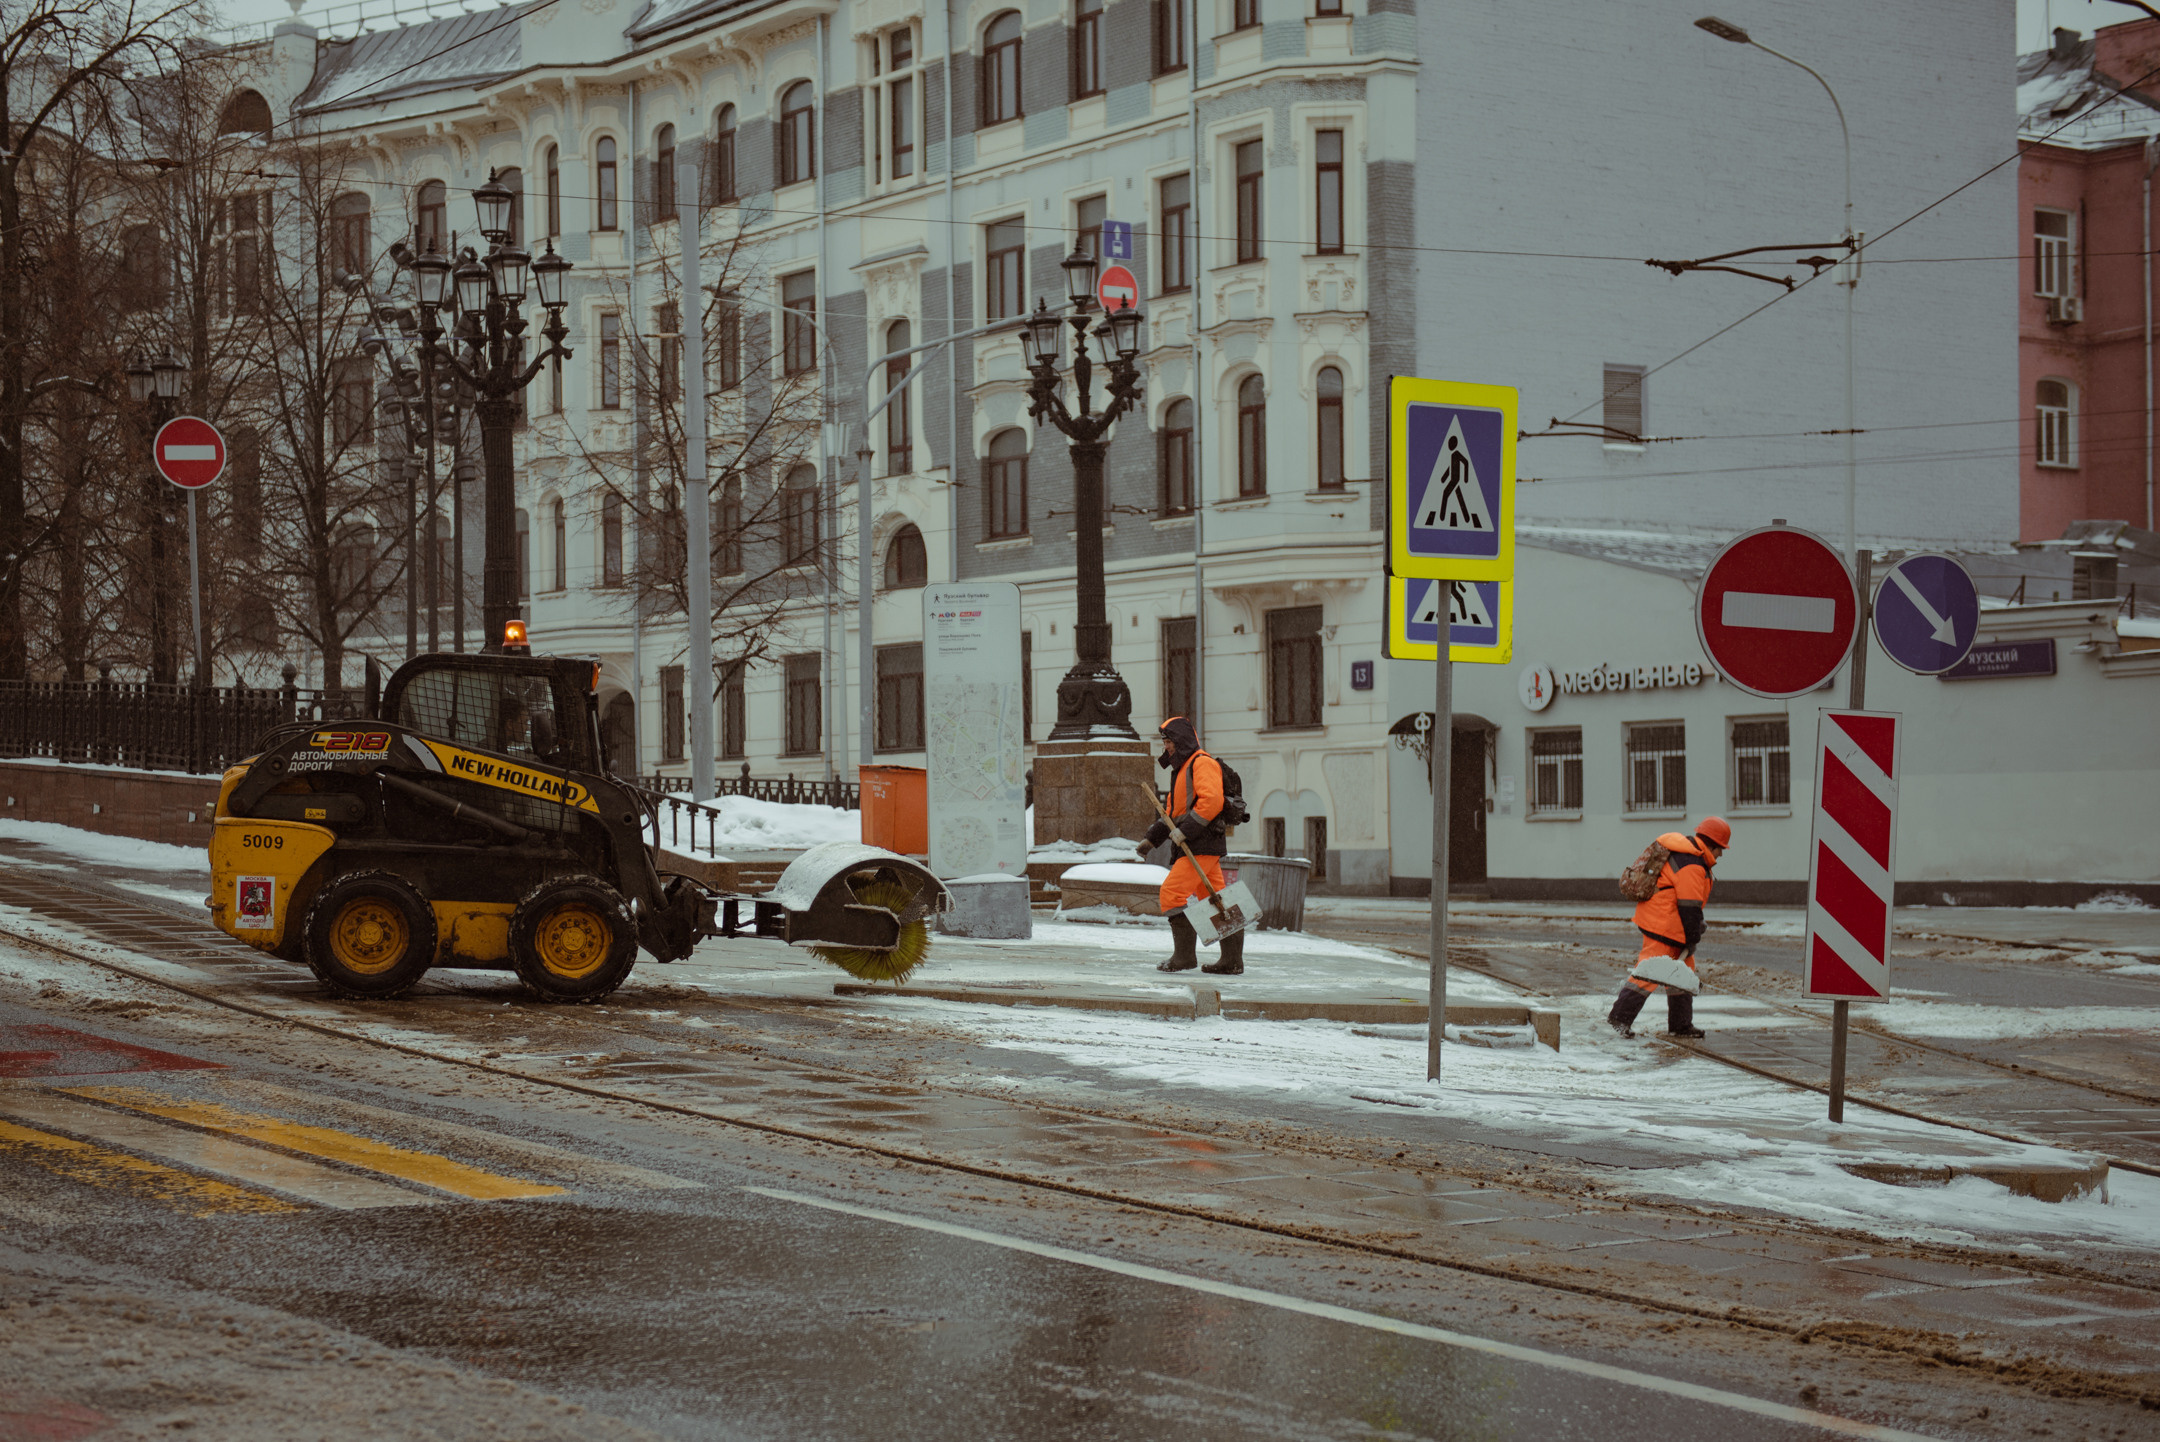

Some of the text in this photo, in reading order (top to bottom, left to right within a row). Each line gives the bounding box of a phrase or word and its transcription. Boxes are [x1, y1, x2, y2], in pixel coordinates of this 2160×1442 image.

[1968, 648, 2019, 665] ЯУЗСКИЙ
[1355, 668, 1367, 683] 13
[1560, 662, 1701, 694] мебельные
[291, 751, 389, 760] АВТОМОБИЛЬНЫЕ
[287, 761, 333, 772] ДОРОГИ
[451, 755, 578, 800] NEW HOLLAND
[242, 834, 284, 850] 5009
